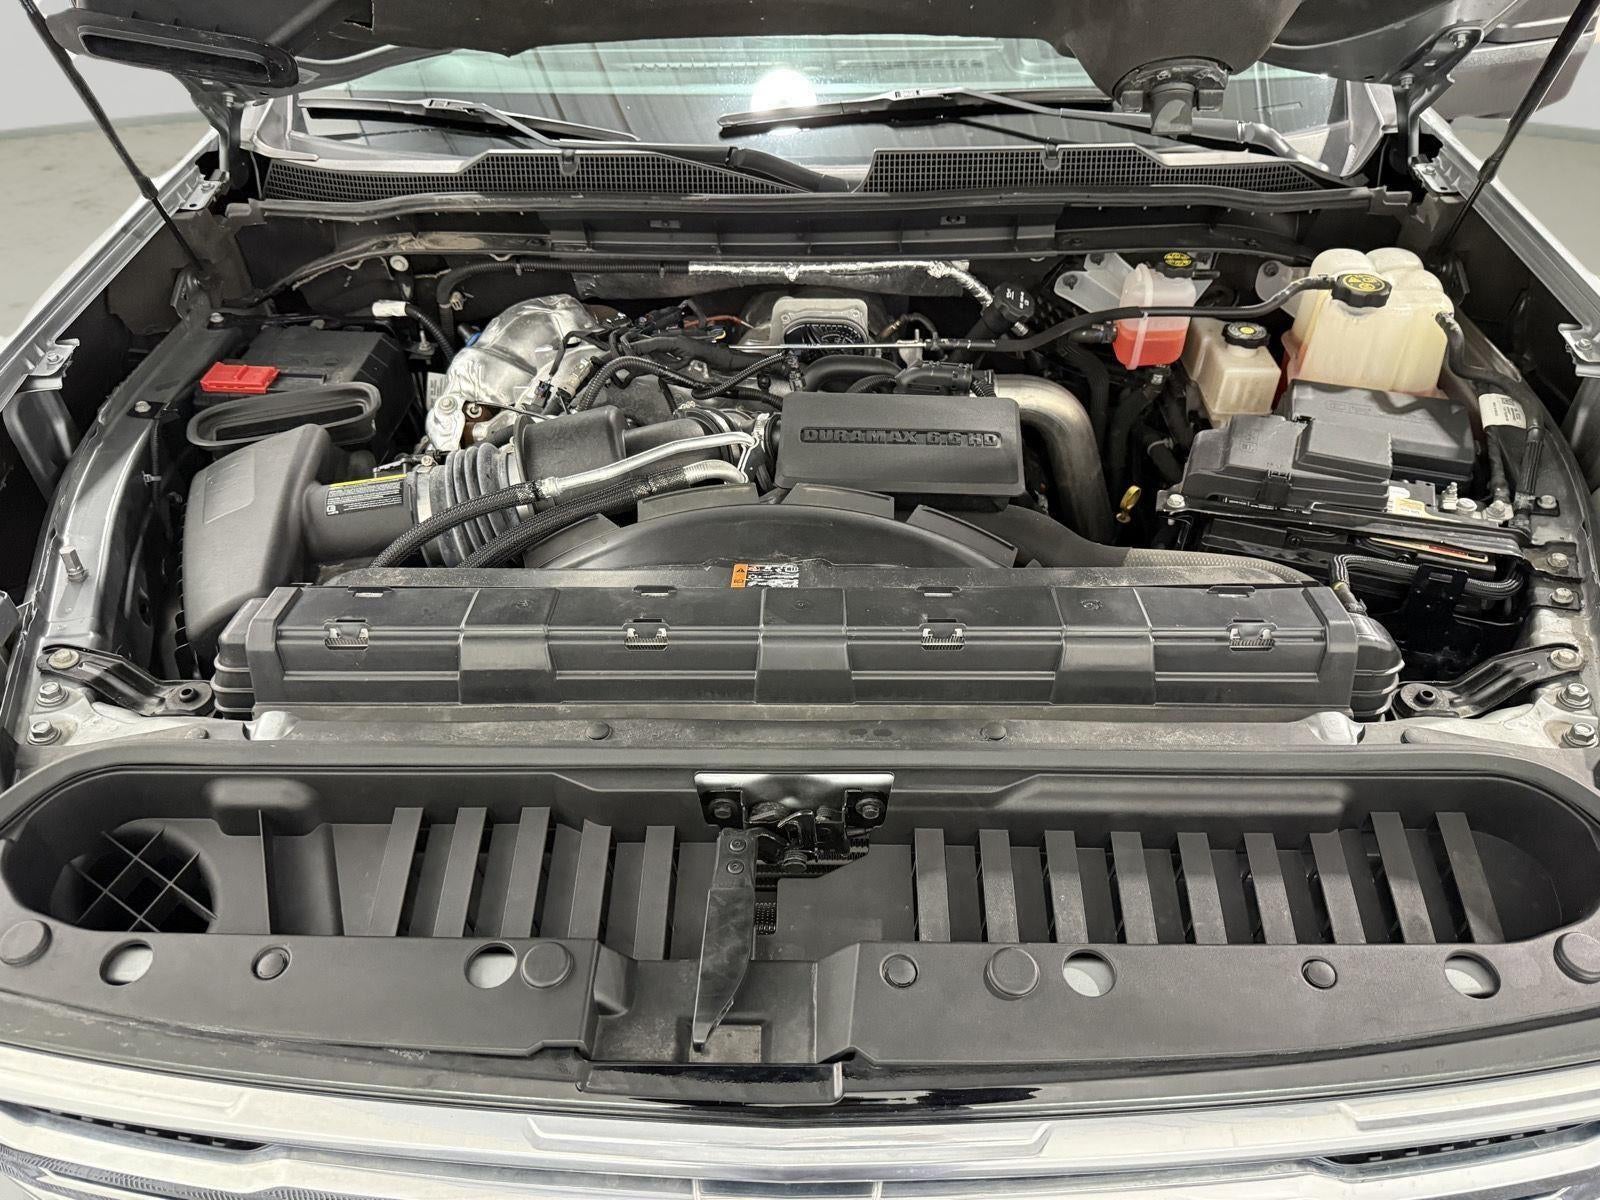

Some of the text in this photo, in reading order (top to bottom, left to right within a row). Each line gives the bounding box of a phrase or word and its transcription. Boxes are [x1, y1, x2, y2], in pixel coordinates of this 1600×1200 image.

[803, 428, 1000, 447] DURAMAX 6.6 HD
